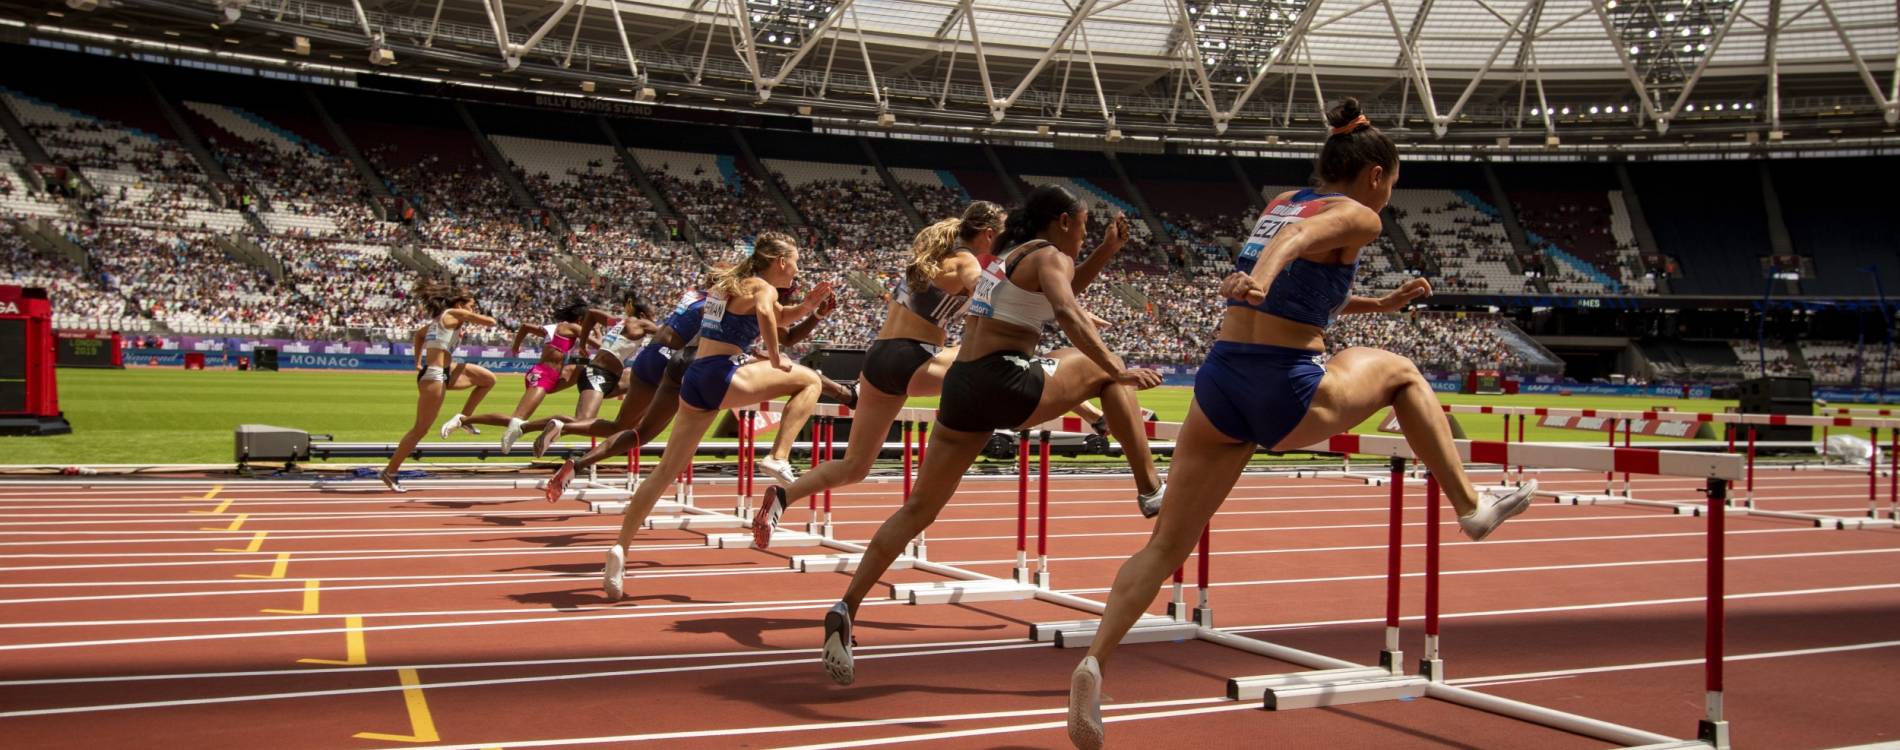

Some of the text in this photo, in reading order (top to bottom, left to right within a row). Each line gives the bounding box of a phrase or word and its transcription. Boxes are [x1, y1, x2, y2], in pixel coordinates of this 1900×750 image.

[536, 95, 653, 115] BILLY BONDS STAND
[290, 354, 359, 368] MONACO
